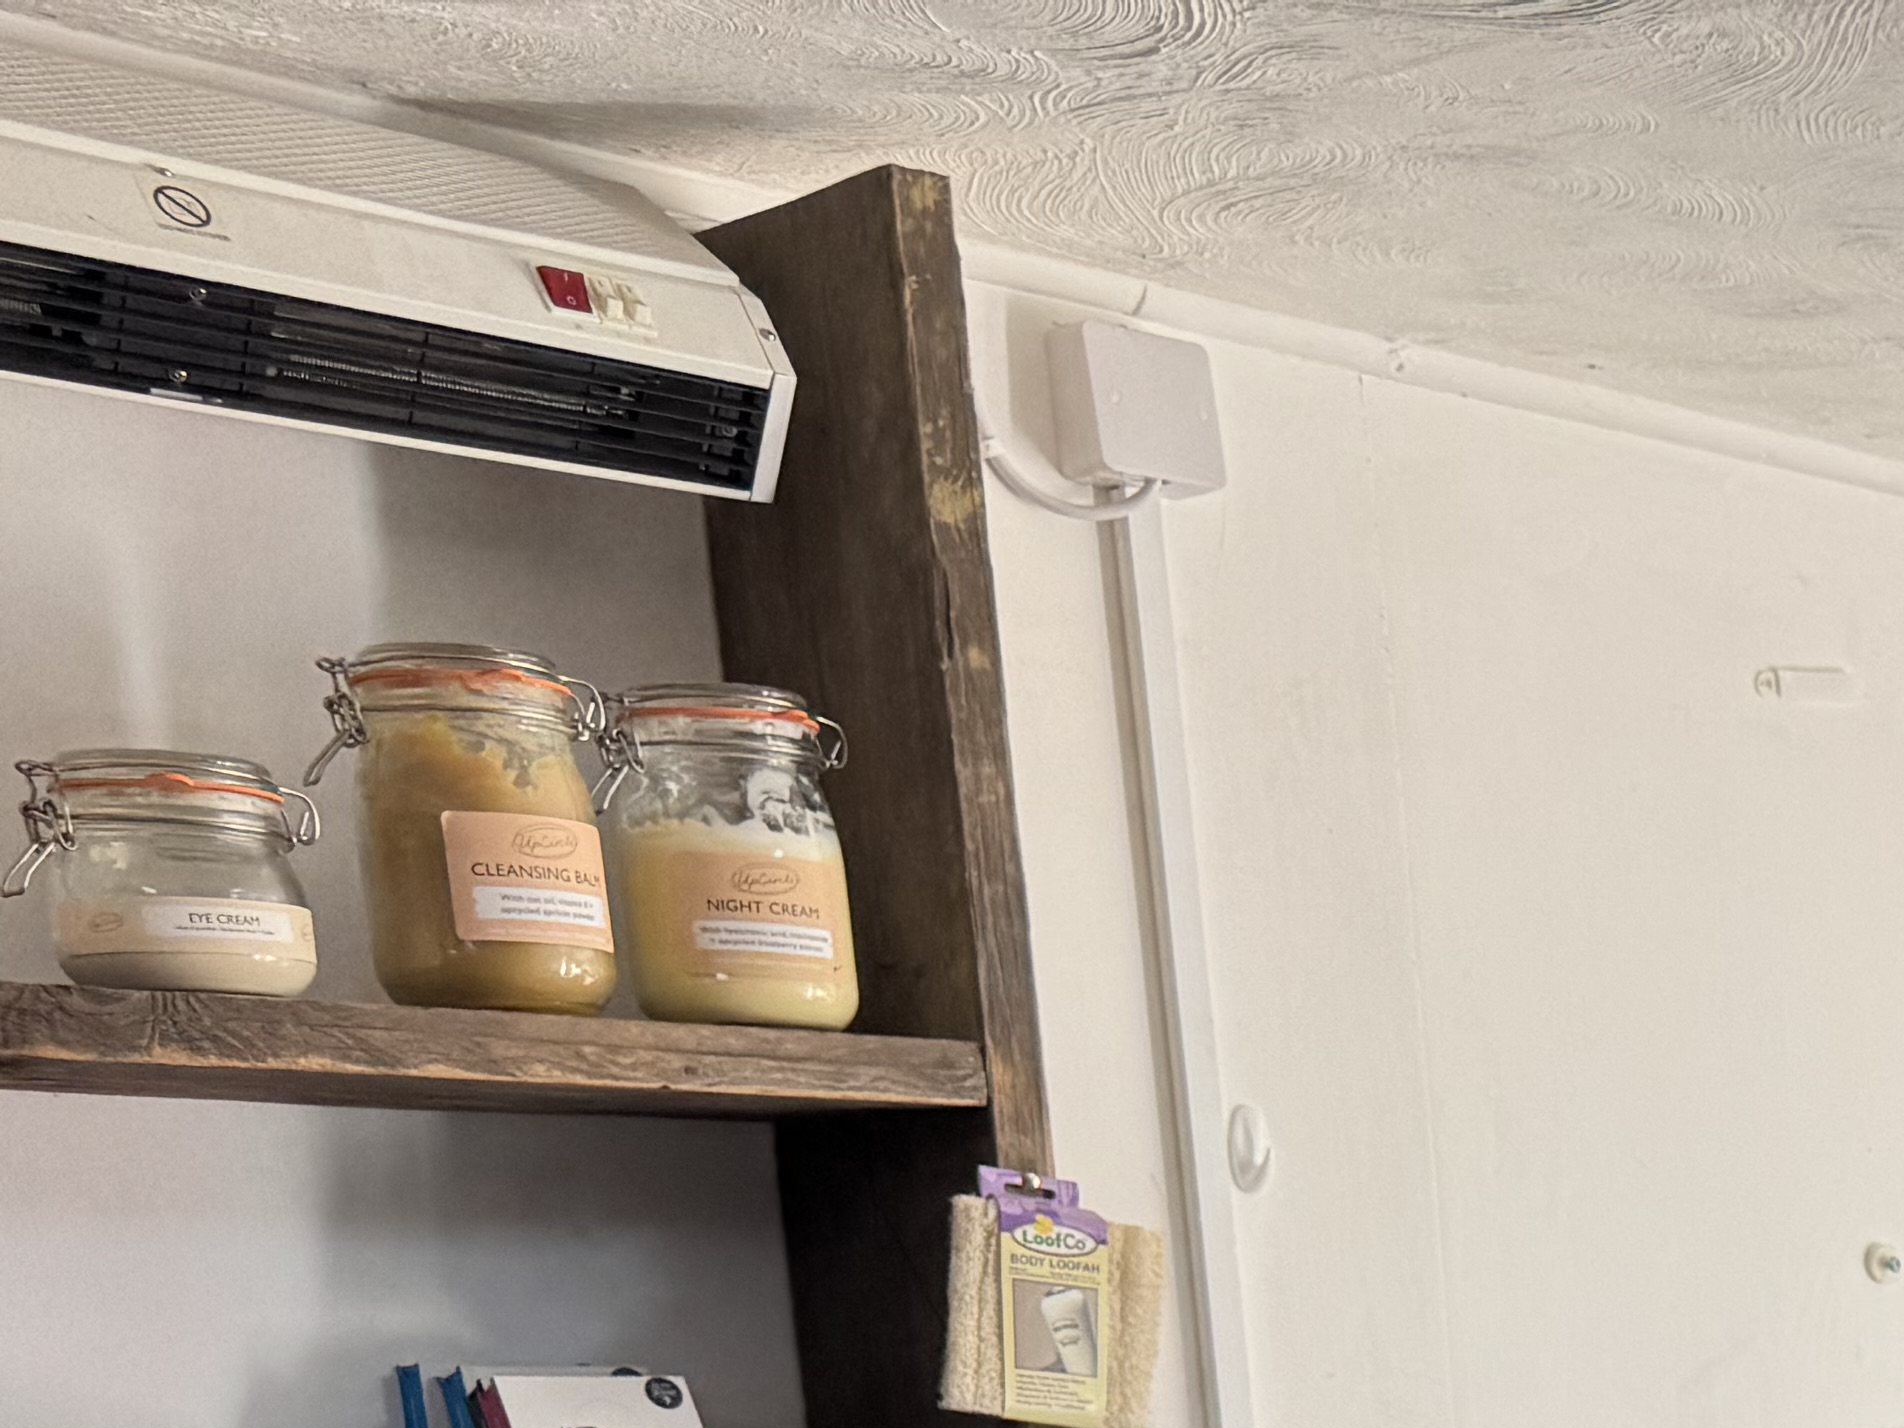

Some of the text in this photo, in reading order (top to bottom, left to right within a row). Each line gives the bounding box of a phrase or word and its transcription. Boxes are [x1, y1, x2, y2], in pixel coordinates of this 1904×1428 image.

[471, 863, 573, 883] CLEANSING
[189, 912, 261, 927] EYE CREAM
[707, 898, 820, 920] NIGHT CREAM
[1021, 1228, 1086, 1254] LoofCo
[1010, 1253, 1101, 1275] BODY LOOFAH
